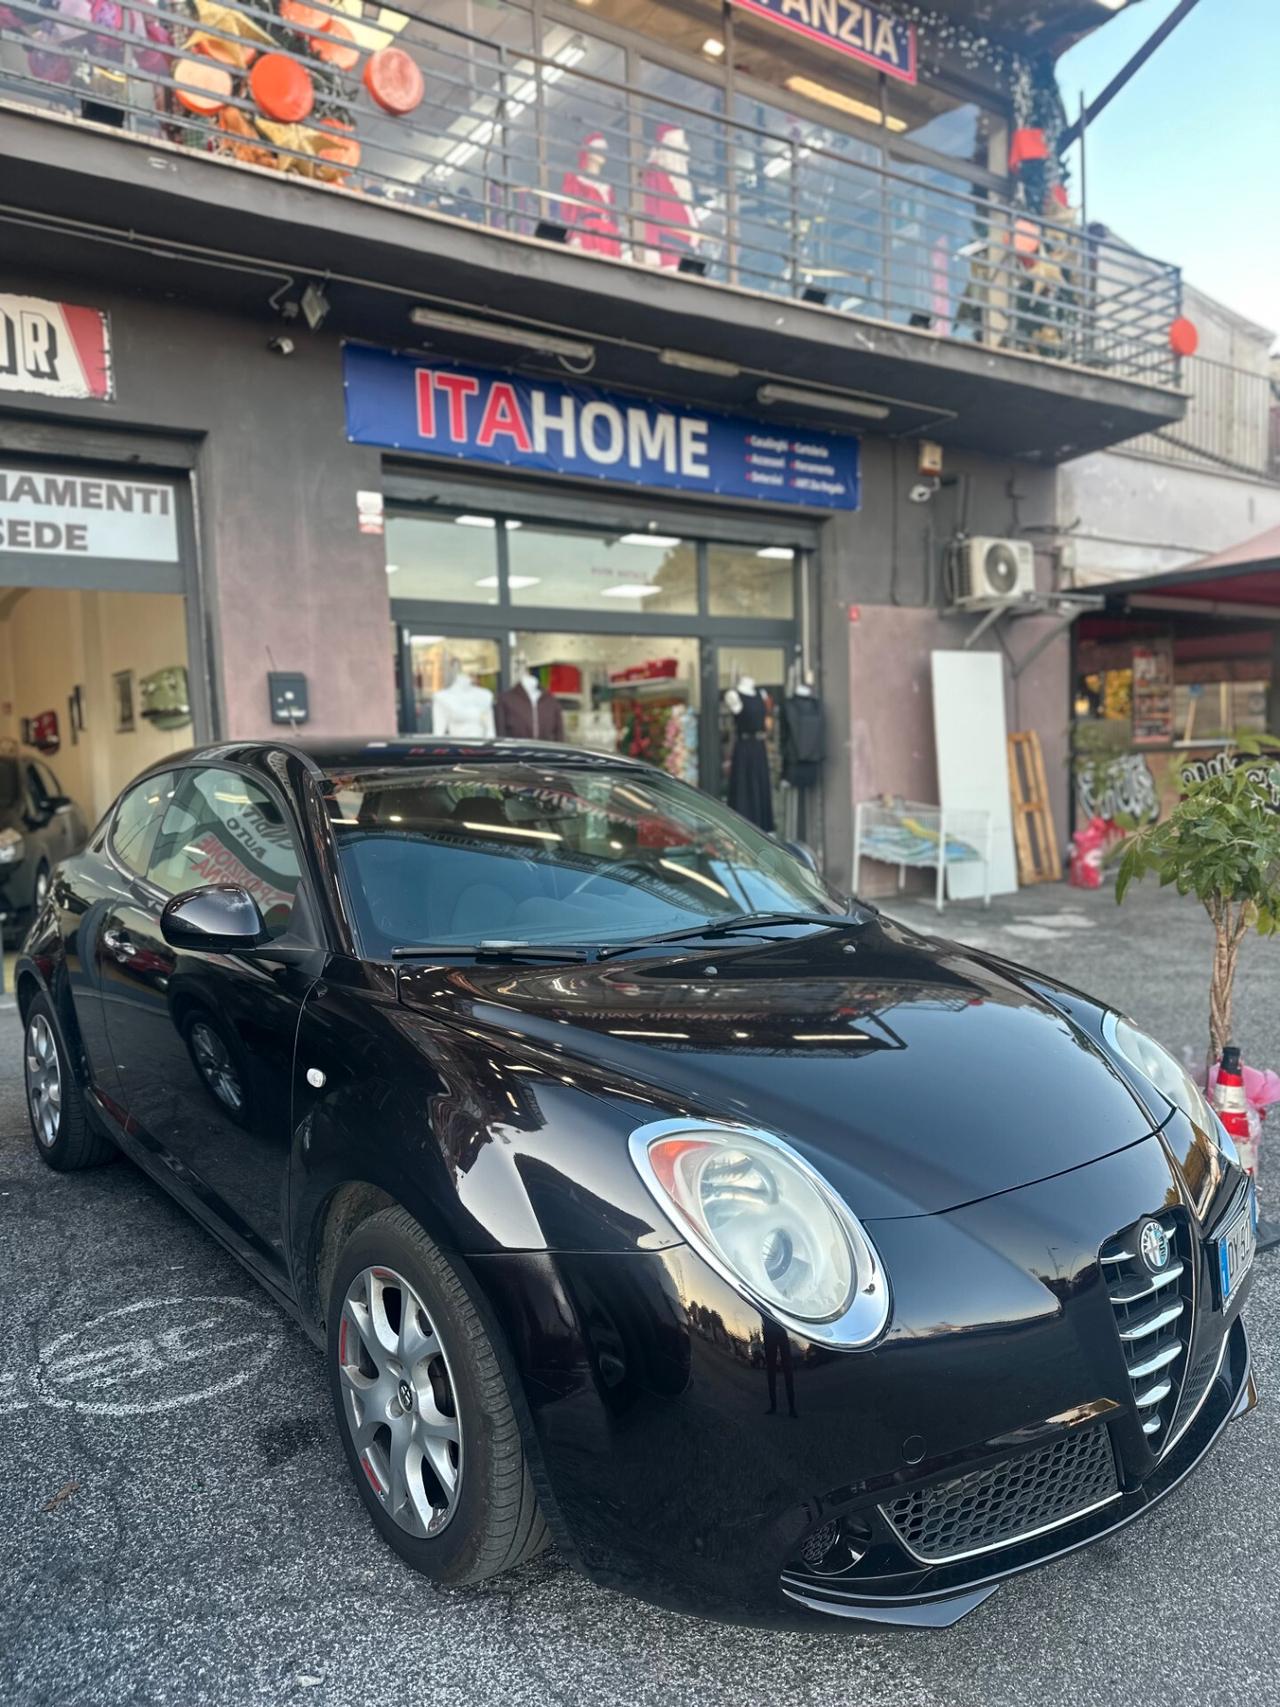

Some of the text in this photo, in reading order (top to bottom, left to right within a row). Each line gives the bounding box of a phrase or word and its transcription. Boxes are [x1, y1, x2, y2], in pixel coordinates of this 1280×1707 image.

[760, 0, 900, 65] ANZIA
[414, 367, 711, 479] ITAHOME
[0, 519, 88, 552] EDE
